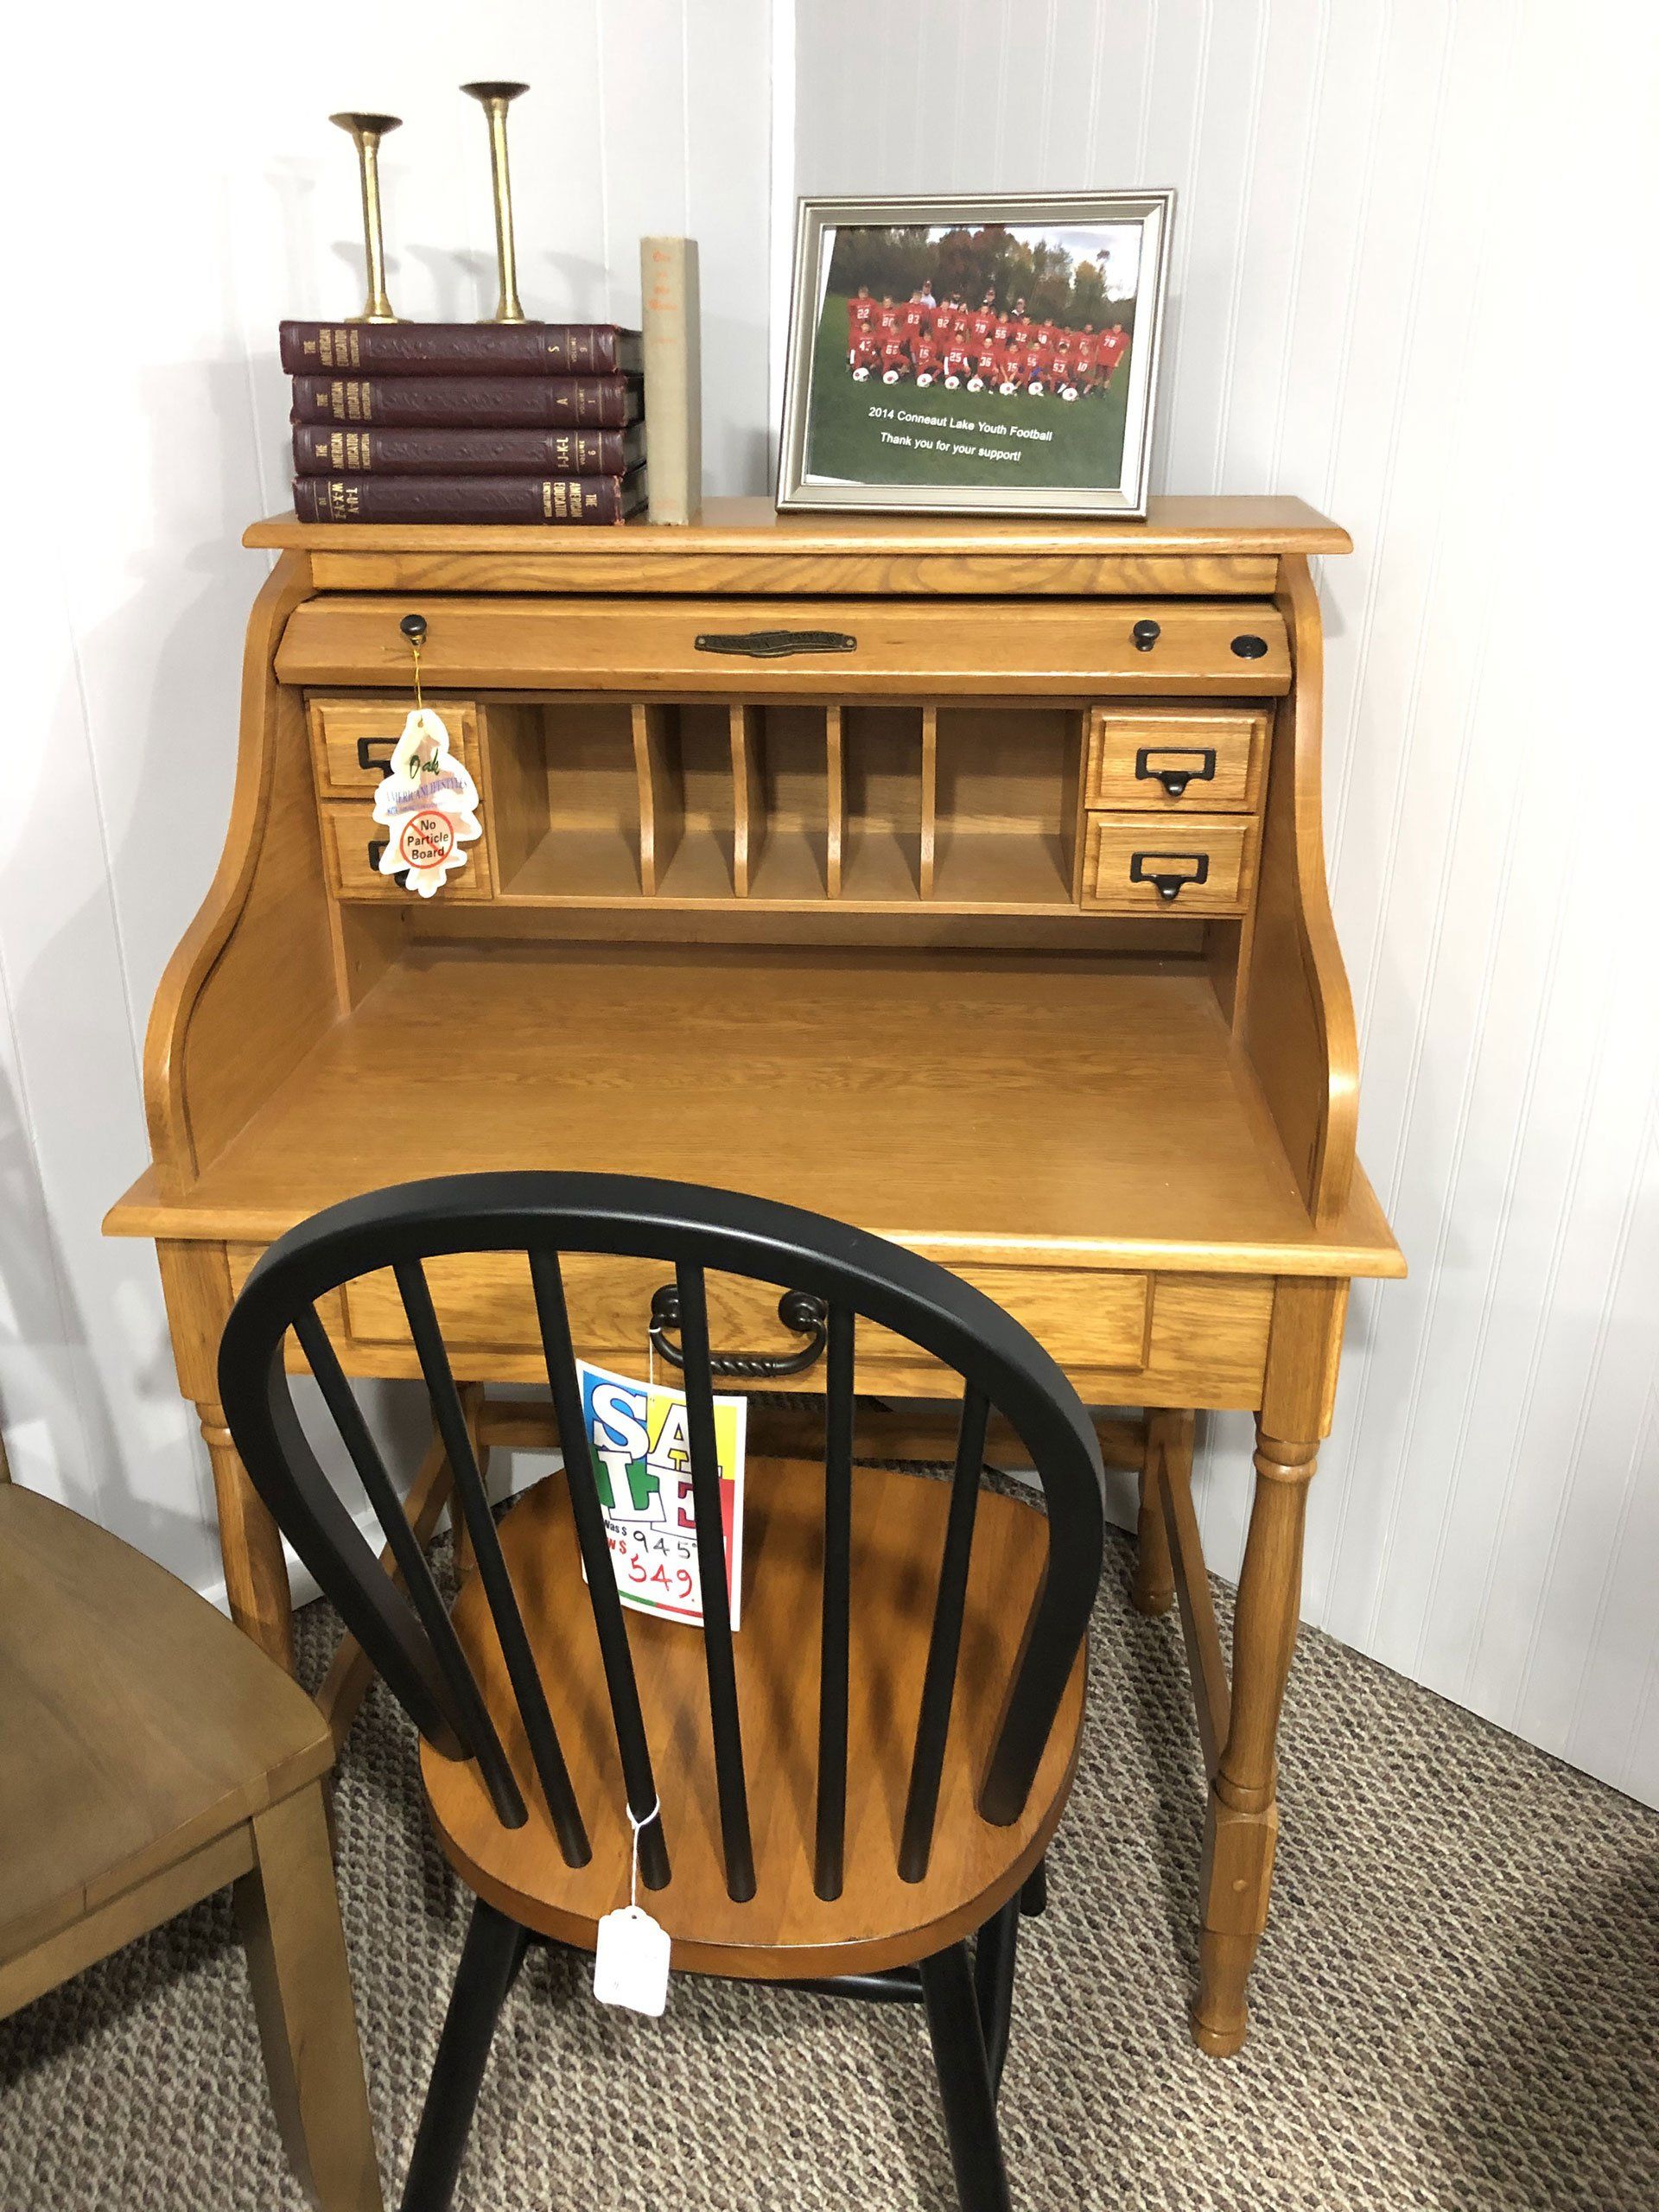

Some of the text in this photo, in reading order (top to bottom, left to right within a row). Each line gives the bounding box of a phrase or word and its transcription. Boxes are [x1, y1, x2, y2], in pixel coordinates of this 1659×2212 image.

[857, 308, 870, 320] 22
[907, 314, 920, 325] 83
[303, 340, 316, 355] THE
[319, 328, 333, 367] AMERICAN
[334, 328, 349, 367] EDUCATOR
[1015, 331, 1027, 343] 32
[949, 352, 962, 363] 25
[316, 392, 328, 407] THE
[331, 381, 345, 420] AMERICAN
[346, 381, 361, 421] EDUCATOR
[556, 397, 569, 406] A
[868, 406, 1053, 442] 2014 Conneaut Lake Youth Football
[315, 443, 327, 457] THE
[330, 432, 345, 470] AMERICAN
[346, 432, 360, 470] EDUCATOR
[880, 432, 1022, 461] Thank you for your support!
[553, 481, 568, 518] EDUCATOR
[569, 481, 583, 518] AMERICAN
[585, 493, 598, 508] THE
[409, 747, 441, 779] Oak
[420, 819, 436, 831] No
[407, 832, 449, 847] Particle
[411, 847, 445, 861] Board
[628, 1553, 693, 1599] 549
